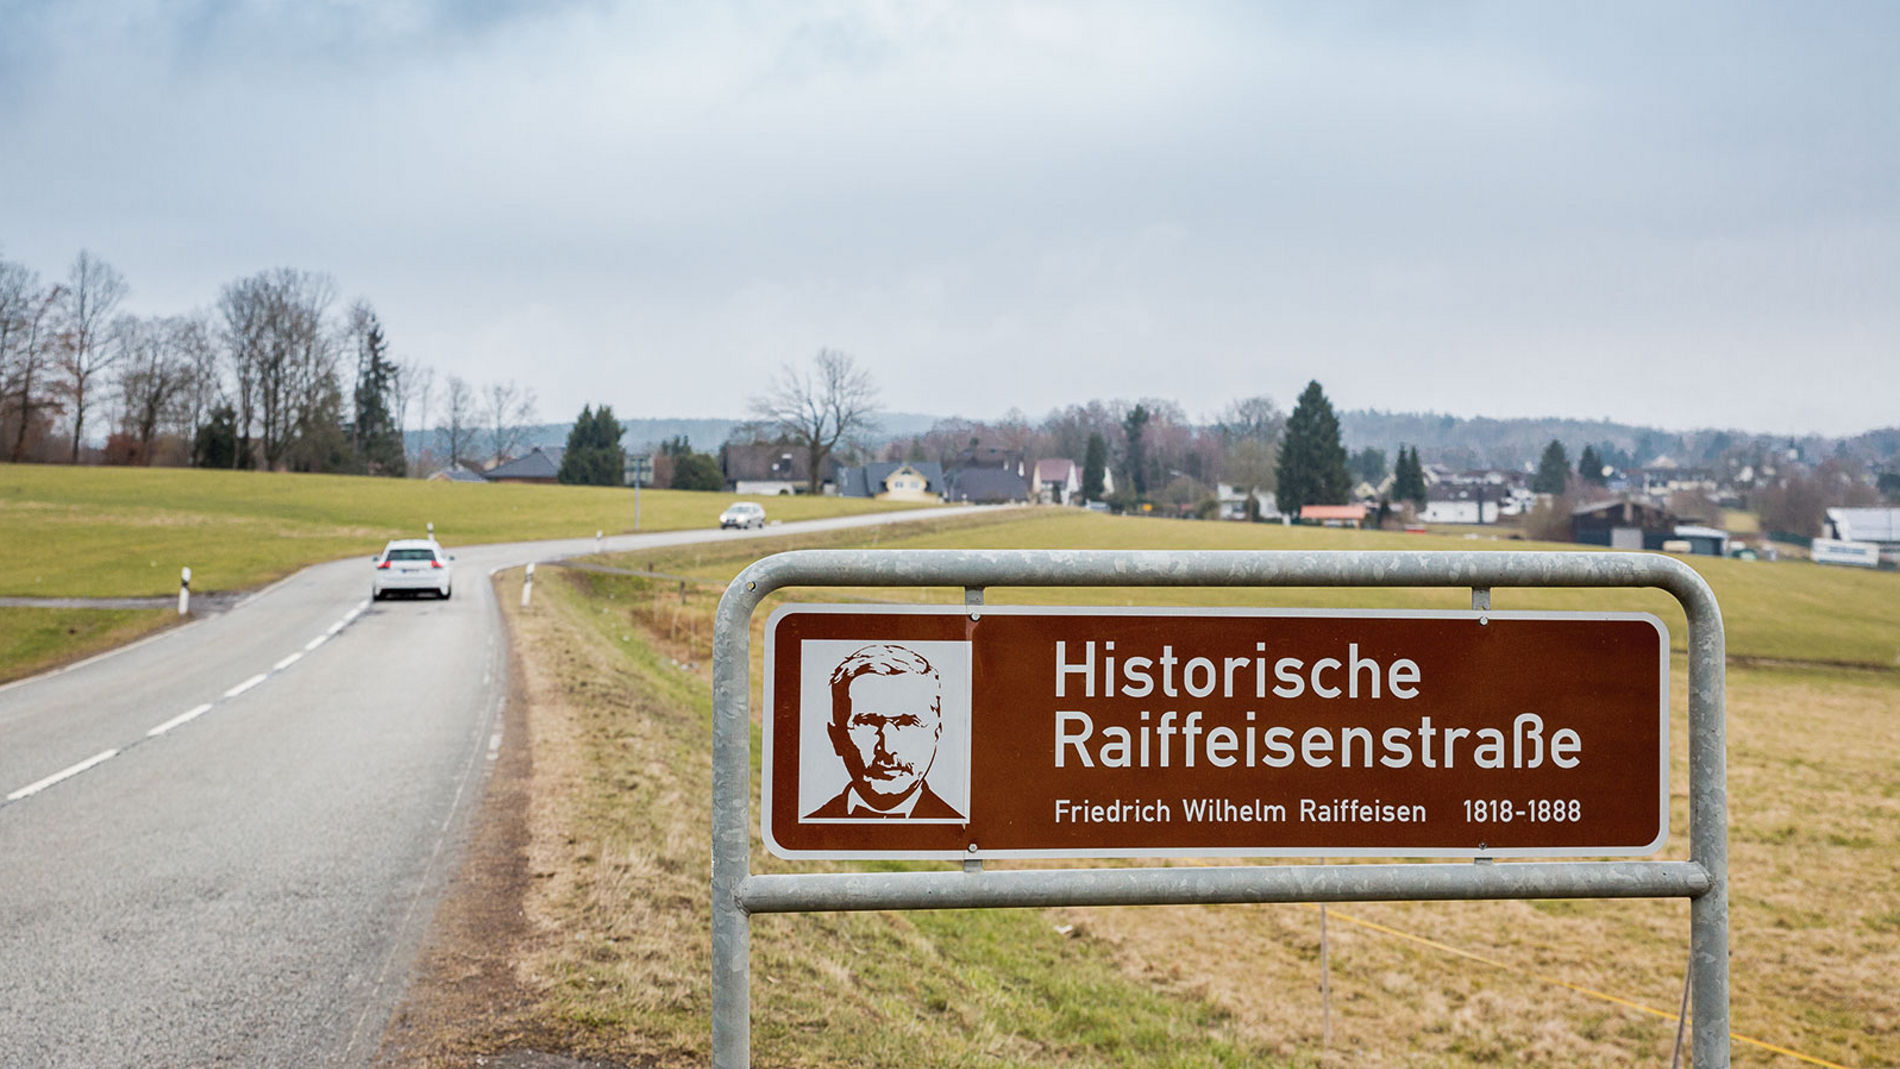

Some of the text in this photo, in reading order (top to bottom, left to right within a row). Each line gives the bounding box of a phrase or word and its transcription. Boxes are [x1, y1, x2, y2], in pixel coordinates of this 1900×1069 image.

[1055, 640, 1421, 699] Historische
[1054, 711, 1583, 769] Raiffeisenstraße
[1055, 798, 1582, 823] Friedrich Wilhelm Raiffeisen 1818-1888
